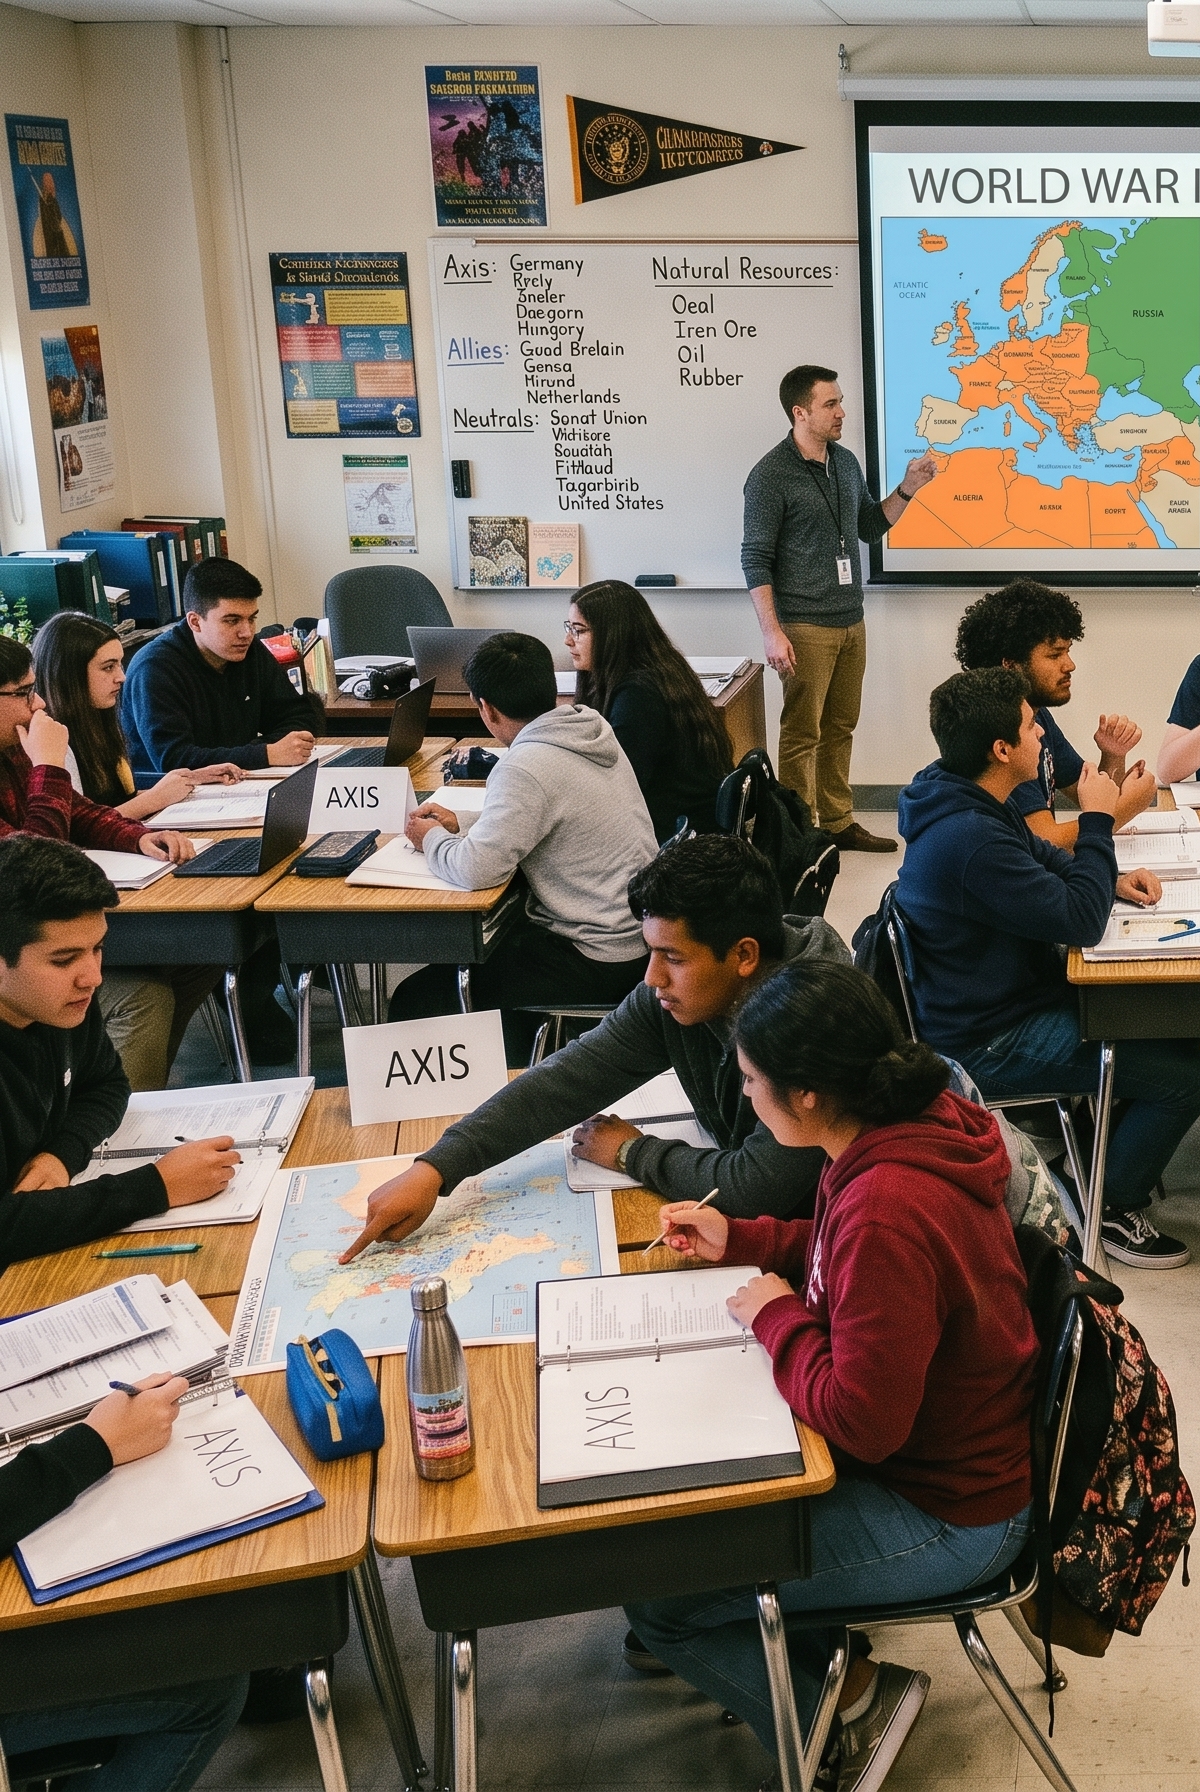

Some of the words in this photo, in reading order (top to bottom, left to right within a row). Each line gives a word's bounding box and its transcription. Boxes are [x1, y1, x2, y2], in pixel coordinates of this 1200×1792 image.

[908, 167, 1070, 205] WORLD
[1082, 167, 1180, 204] WAR
[444, 254, 497, 279] Axis:
[510, 254, 584, 277] Germany
[652, 256, 730, 280] Natural
[740, 256, 839, 280] Resources:
[1132, 309, 1164, 318] RUSSIA
[674, 320, 717, 339] Iren
[724, 320, 758, 338] Ore
[448, 337, 509, 360] Allies:
[571, 340, 624, 356] Brelain
[678, 344, 704, 363] Oil
[524, 358, 572, 373] Gensa
[680, 368, 744, 386] Rubber
[527, 388, 620, 404] Netherlands
[454, 408, 539, 428] Neutrals:
[550, 409, 597, 426] Sonat
[558, 494, 610, 510] United
[616, 494, 664, 510] States
[326, 786, 380, 808] AXIS
[386, 1044, 470, 1088] AXIS
[584, 1386, 636, 1450] AXIS
[184, 1428, 262, 1488] AXIS
